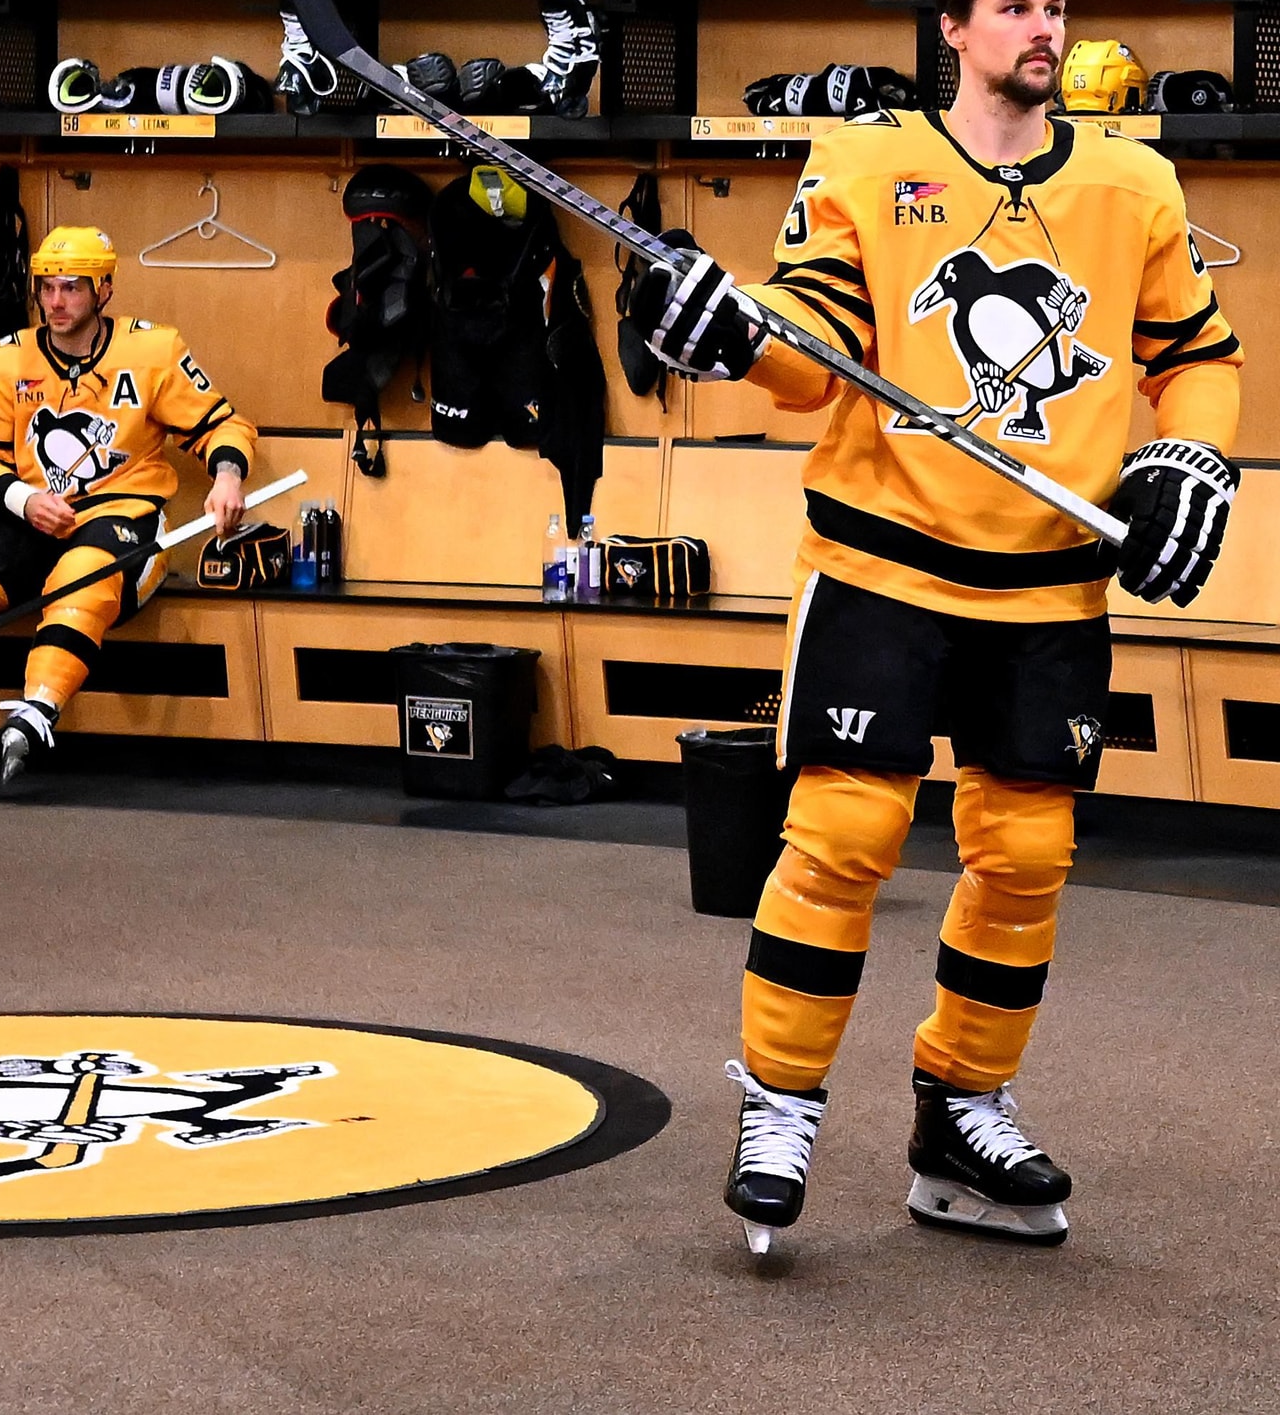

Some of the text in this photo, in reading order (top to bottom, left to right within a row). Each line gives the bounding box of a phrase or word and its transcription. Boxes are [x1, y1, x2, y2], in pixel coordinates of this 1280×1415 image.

[1073, 74, 1087, 89] 65
[63, 116, 79, 132] 58
[379, 118, 387, 133] 7
[693, 119, 811, 135] 75 CONNOR CLIFTON
[784, 175, 827, 249] 5
[108, 368, 144, 409] A
[1123, 442, 1237, 492] ARRIOR
[409, 706, 468, 723] PENGUINS
